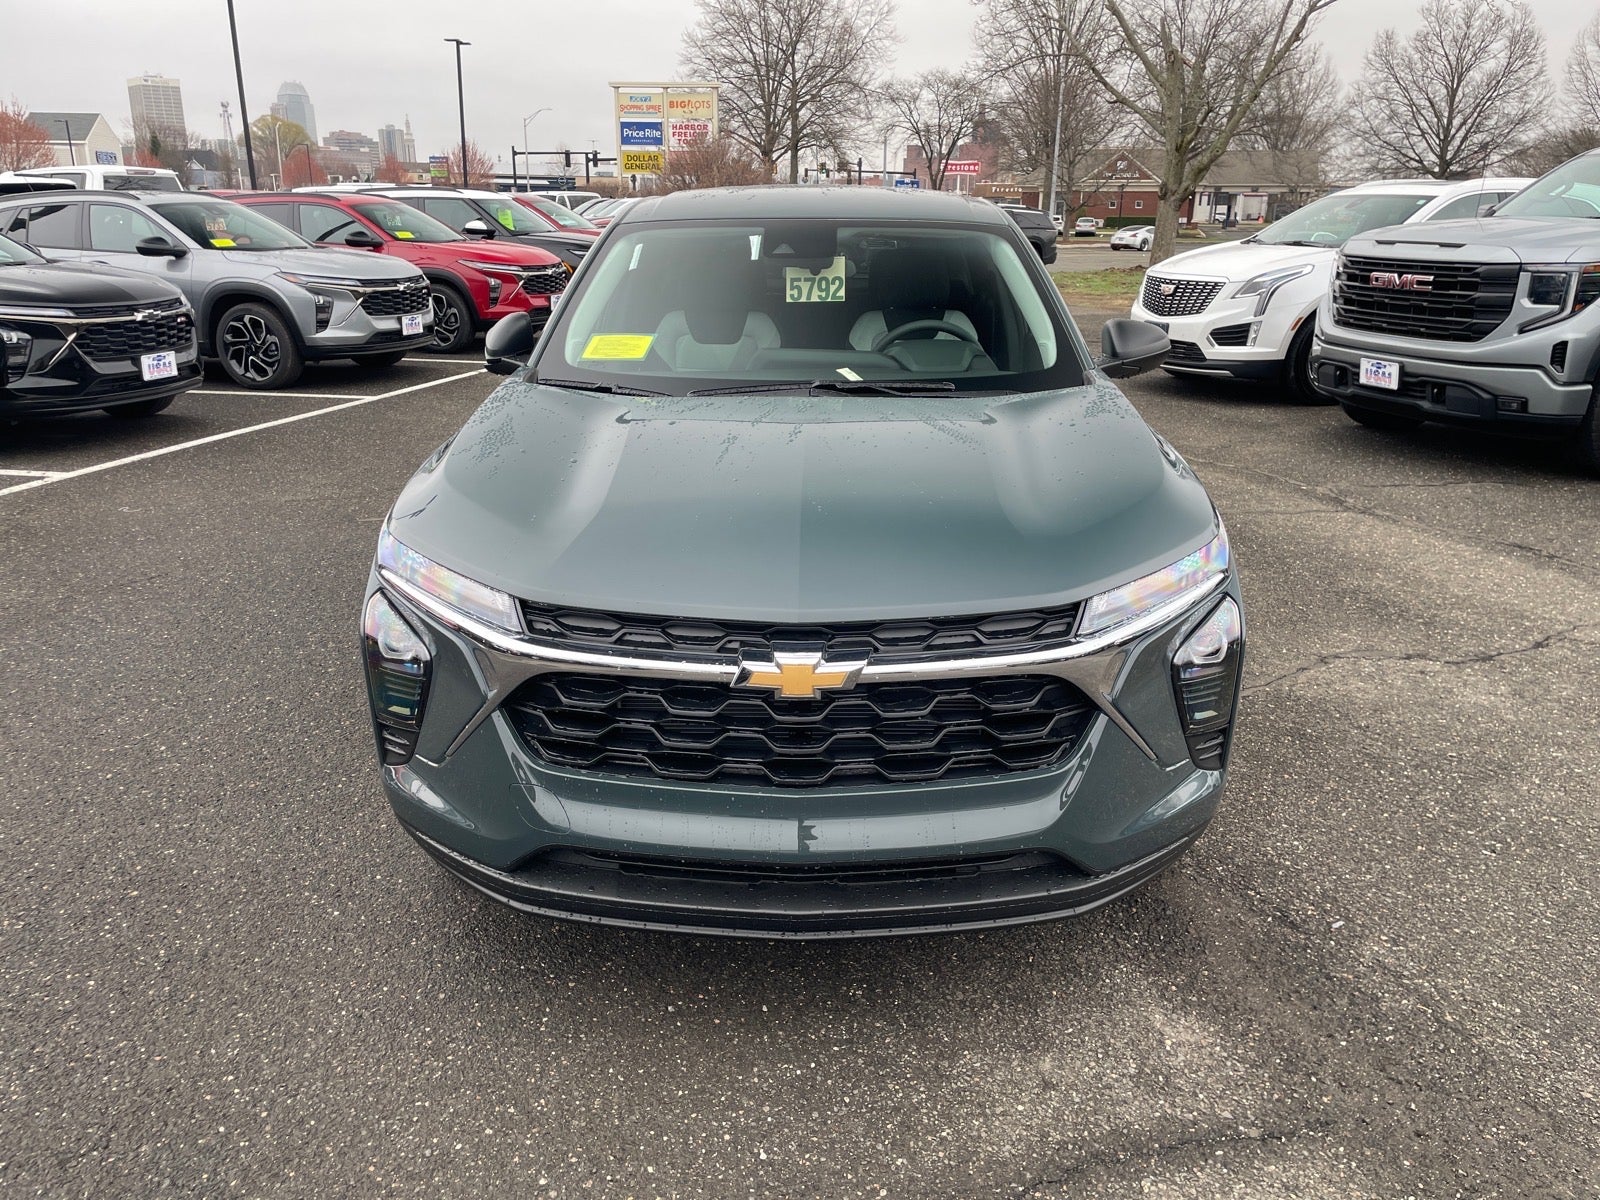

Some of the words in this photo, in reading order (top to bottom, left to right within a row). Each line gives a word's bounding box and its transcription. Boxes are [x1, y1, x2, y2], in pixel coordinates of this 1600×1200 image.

[620, 104, 644, 112] SHOPPING
[646, 104, 662, 113] SPREE
[691, 100, 711, 110] LOTS
[626, 154, 659, 162] DOLLAR
[624, 162, 660, 170] GENERAL
[940, 163, 979, 171] Frestone
[1370, 272, 1434, 291] GMC
[789, 276, 844, 302] 5792
